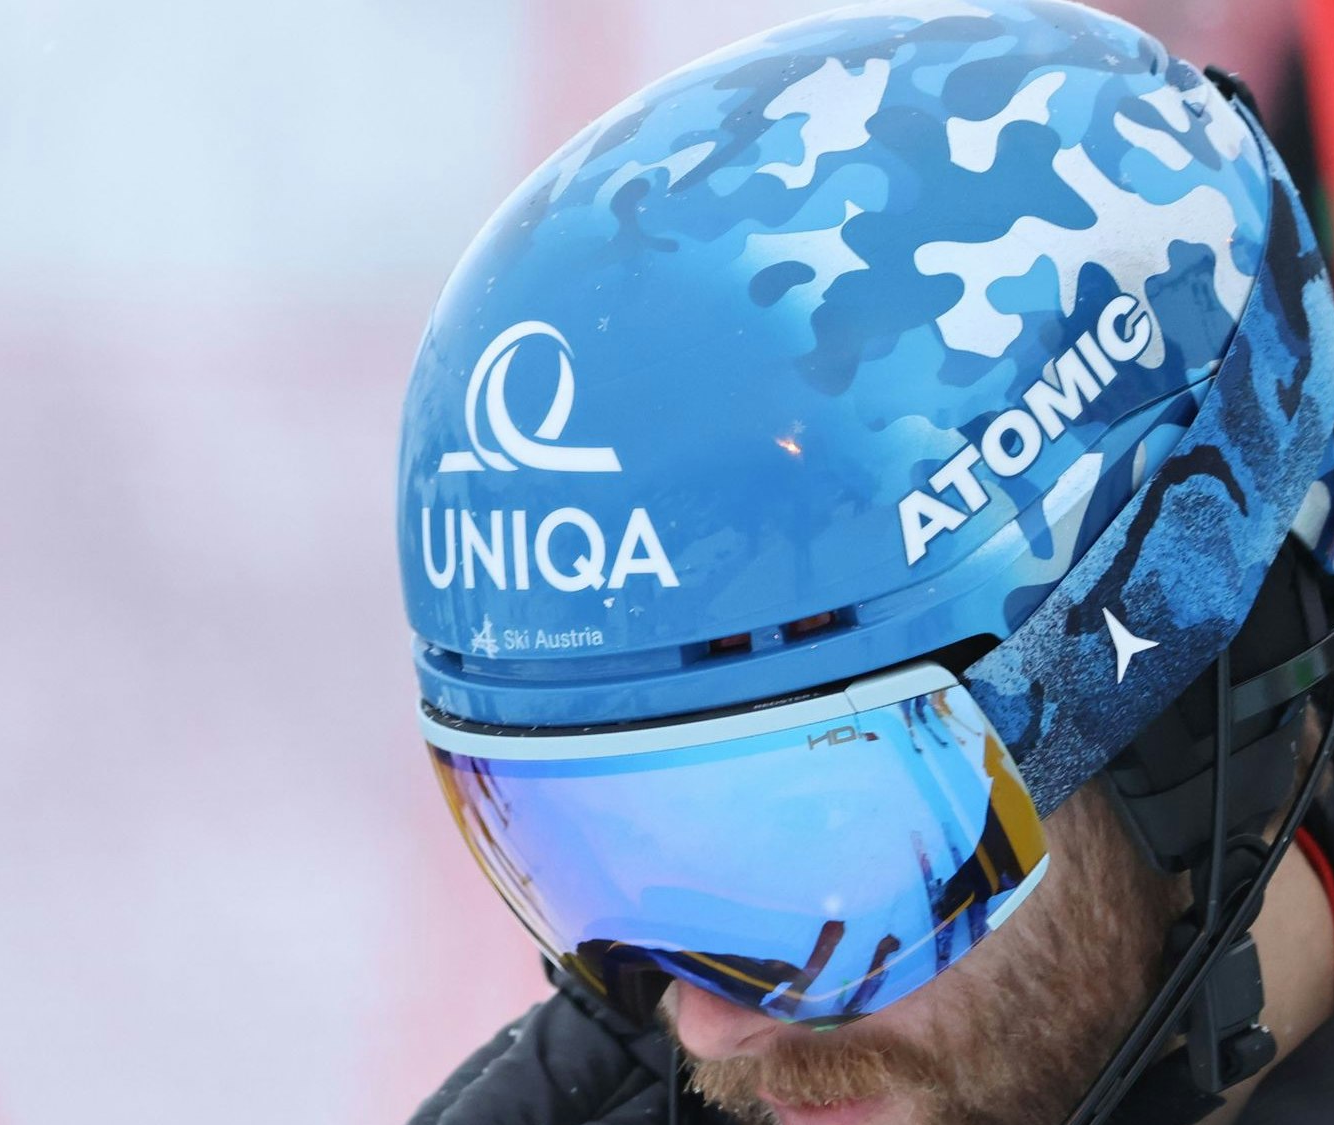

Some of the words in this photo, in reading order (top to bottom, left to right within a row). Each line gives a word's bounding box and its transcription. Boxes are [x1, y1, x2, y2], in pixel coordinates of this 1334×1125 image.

[898, 295, 1152, 566] ATOMIC
[422, 507, 681, 592] UNIQA
[503, 629, 530, 650] Ski
[535, 626, 603, 649] Austria
